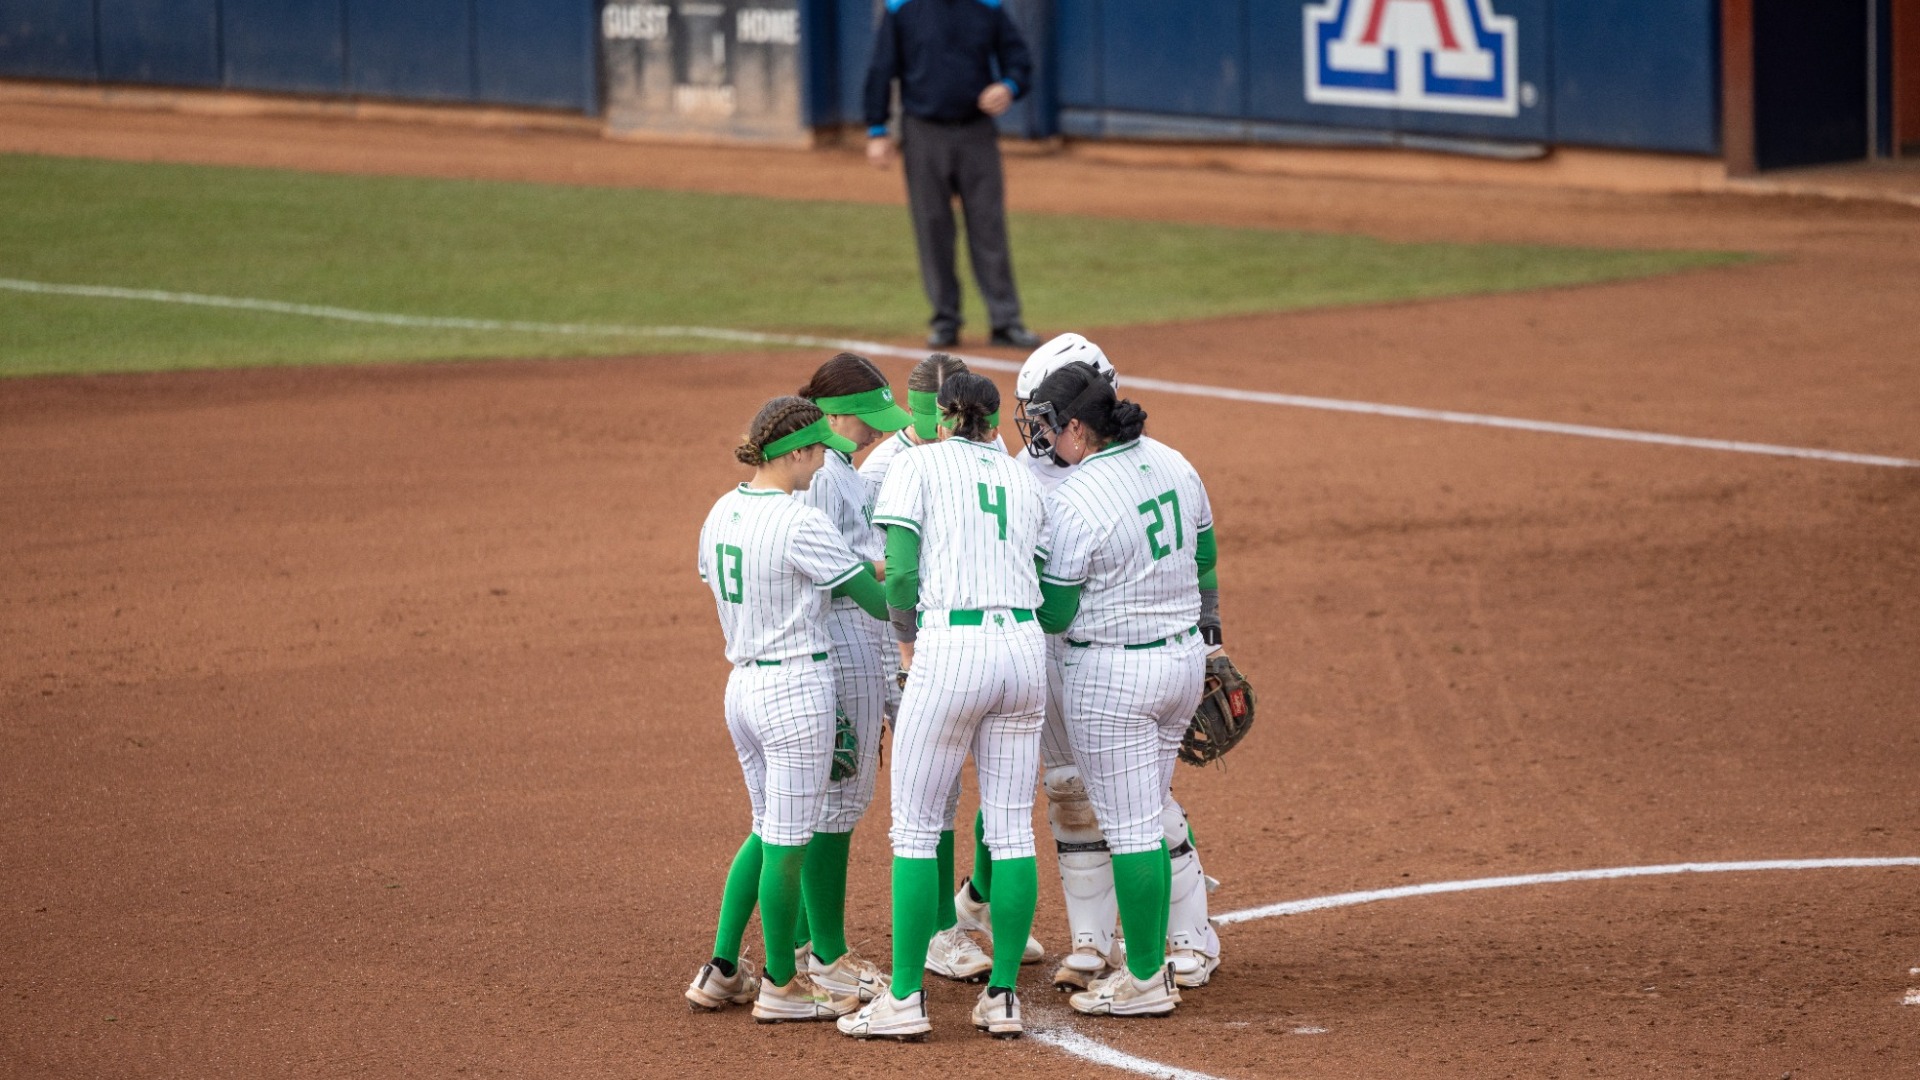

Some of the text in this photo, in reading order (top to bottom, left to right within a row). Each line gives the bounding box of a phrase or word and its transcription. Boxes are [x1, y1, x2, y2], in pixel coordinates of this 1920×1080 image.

[603, 4, 671, 39] GUEST
[736, 8, 800, 45] HOME
[1304, 0, 1518, 117] A
[977, 482, 1008, 541] 4
[1137, 489, 1184, 562] 27
[715, 543, 743, 604] 13
